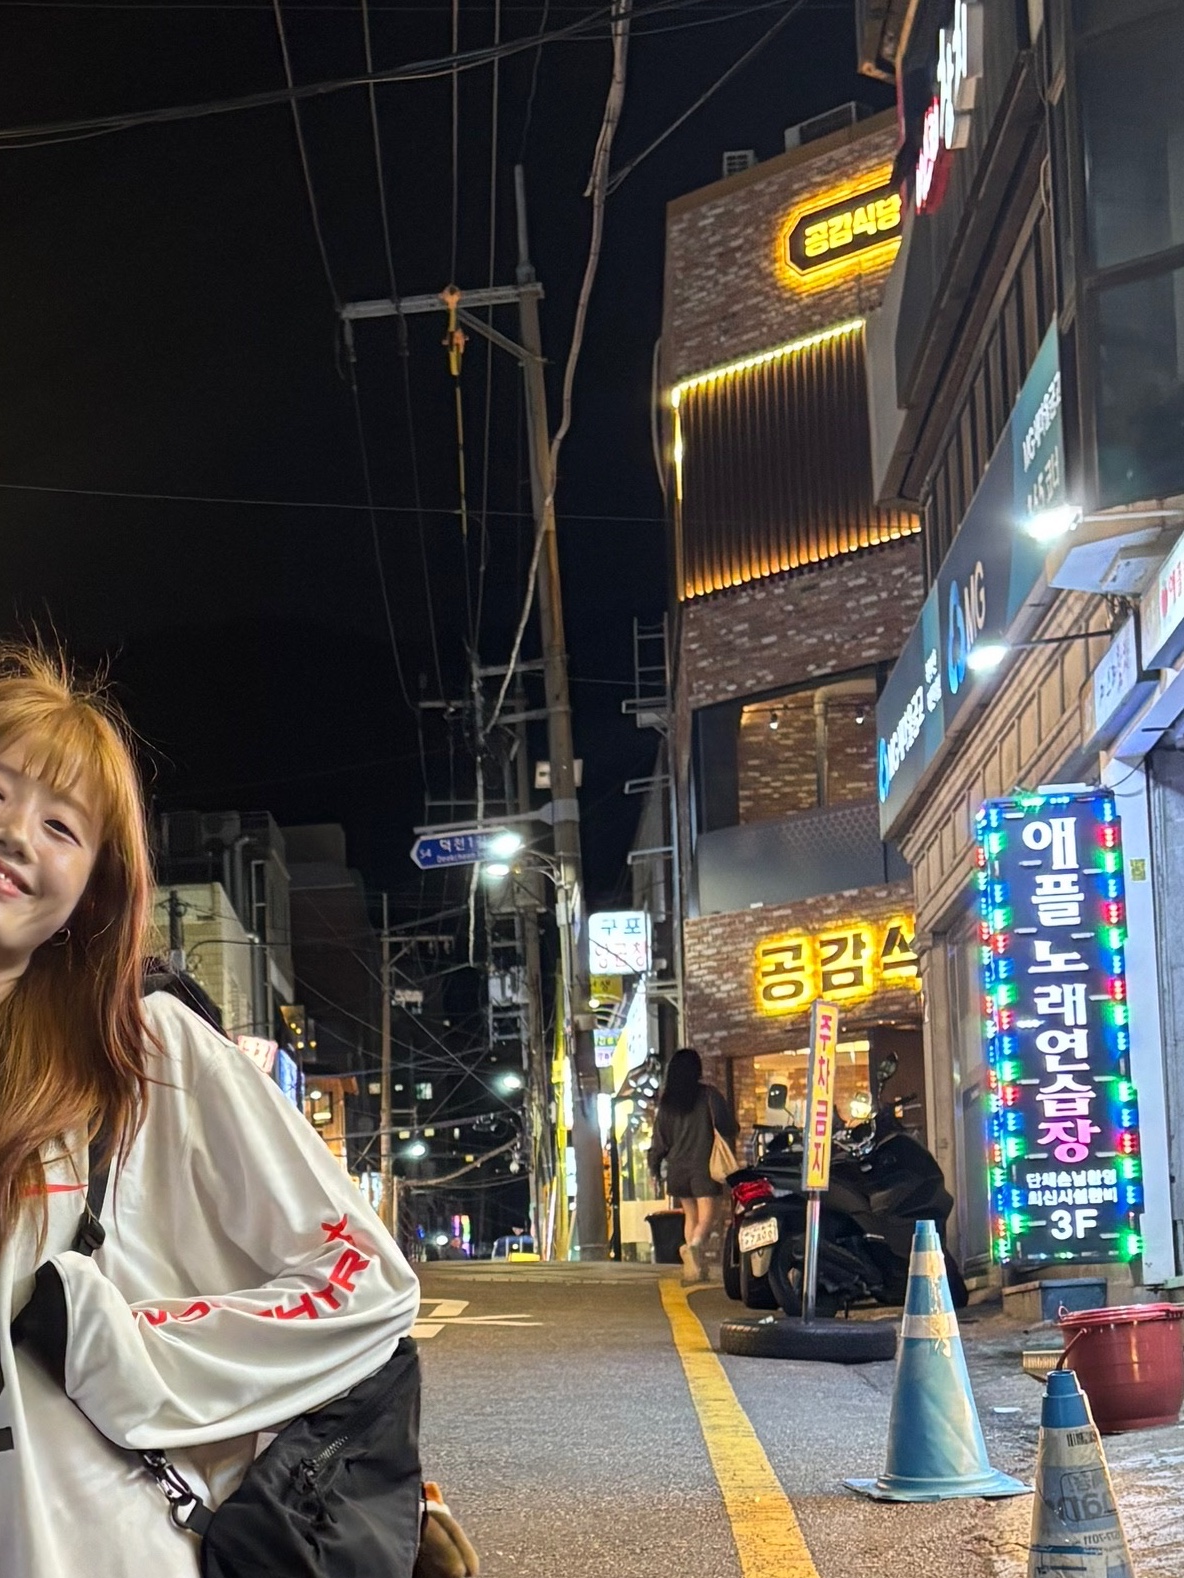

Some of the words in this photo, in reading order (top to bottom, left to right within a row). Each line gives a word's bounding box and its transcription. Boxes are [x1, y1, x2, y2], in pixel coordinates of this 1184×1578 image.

[804, 193, 903, 258] 공감식당
[964, 560, 986, 655] MG
[601, 917, 642, 936] 구포
[812, 1014, 833, 1180] 주차금지
[1050, 1208, 1099, 1240] 3F
